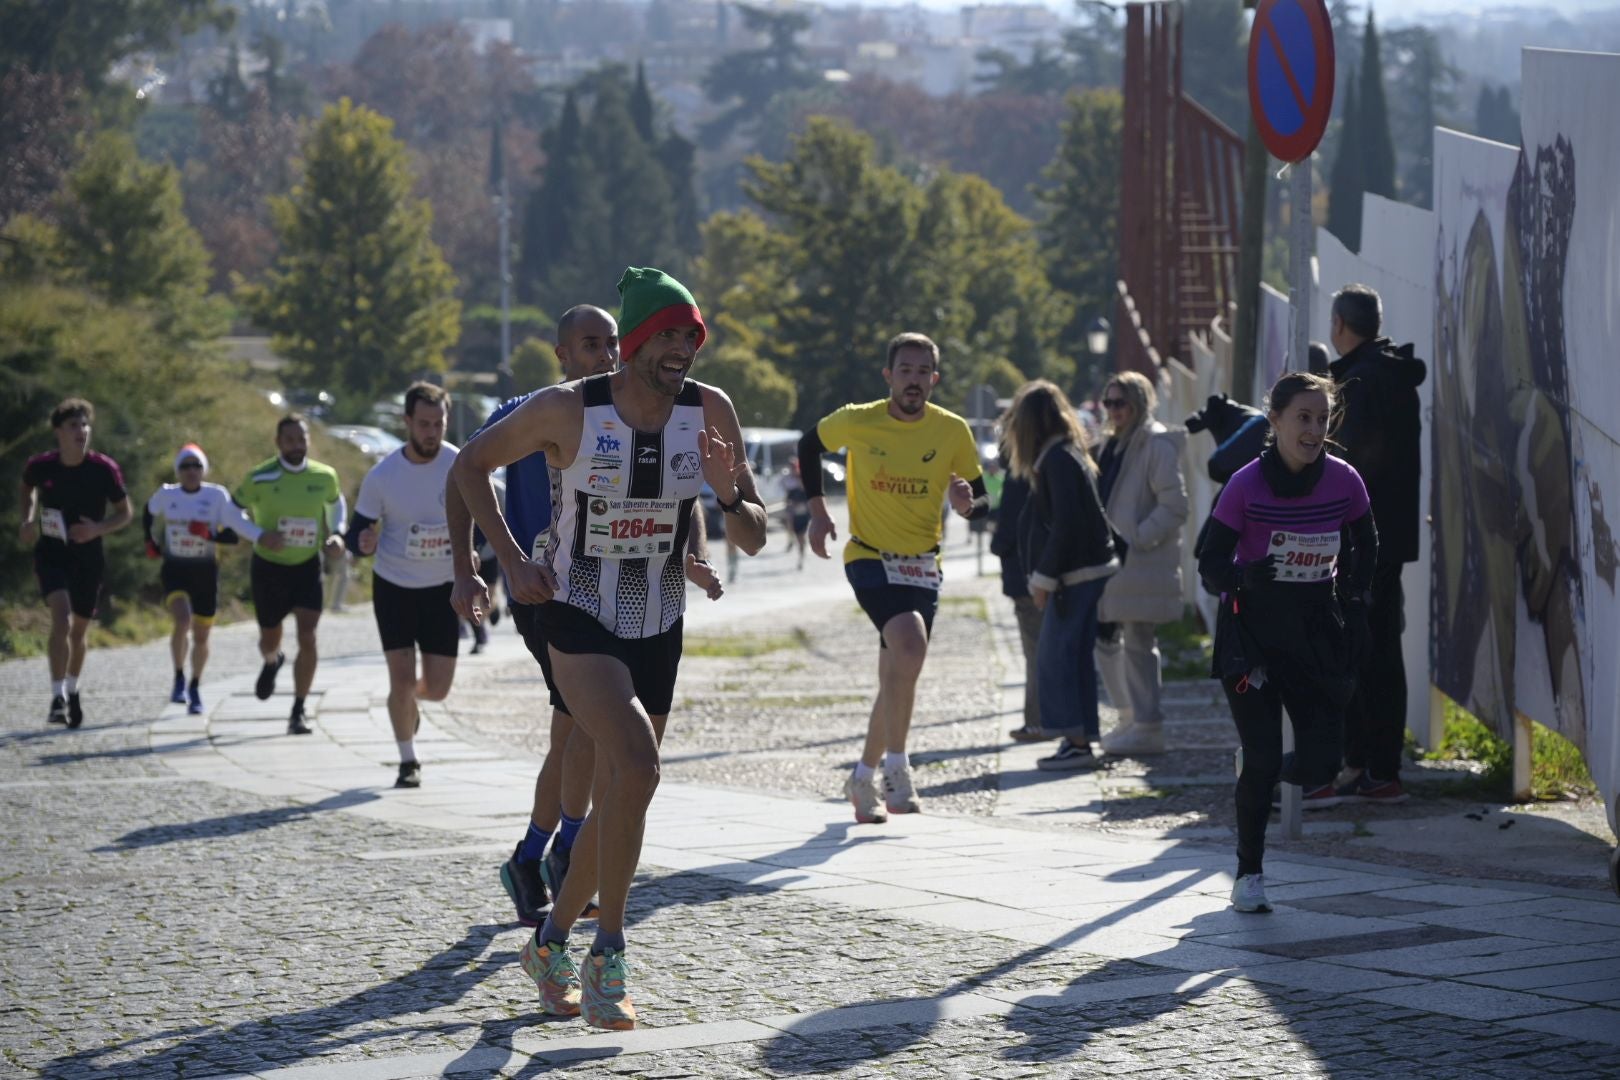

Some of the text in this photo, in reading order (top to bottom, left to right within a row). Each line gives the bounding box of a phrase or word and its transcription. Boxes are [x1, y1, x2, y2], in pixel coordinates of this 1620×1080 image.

[869, 479, 929, 495] SEVILLA
[610, 500, 621, 510] San
[622, 500, 649, 509] Silvestre
[609, 518, 655, 539] 1264
[1284, 551, 1321, 567] 2401
[898, 564, 923, 578] 606
